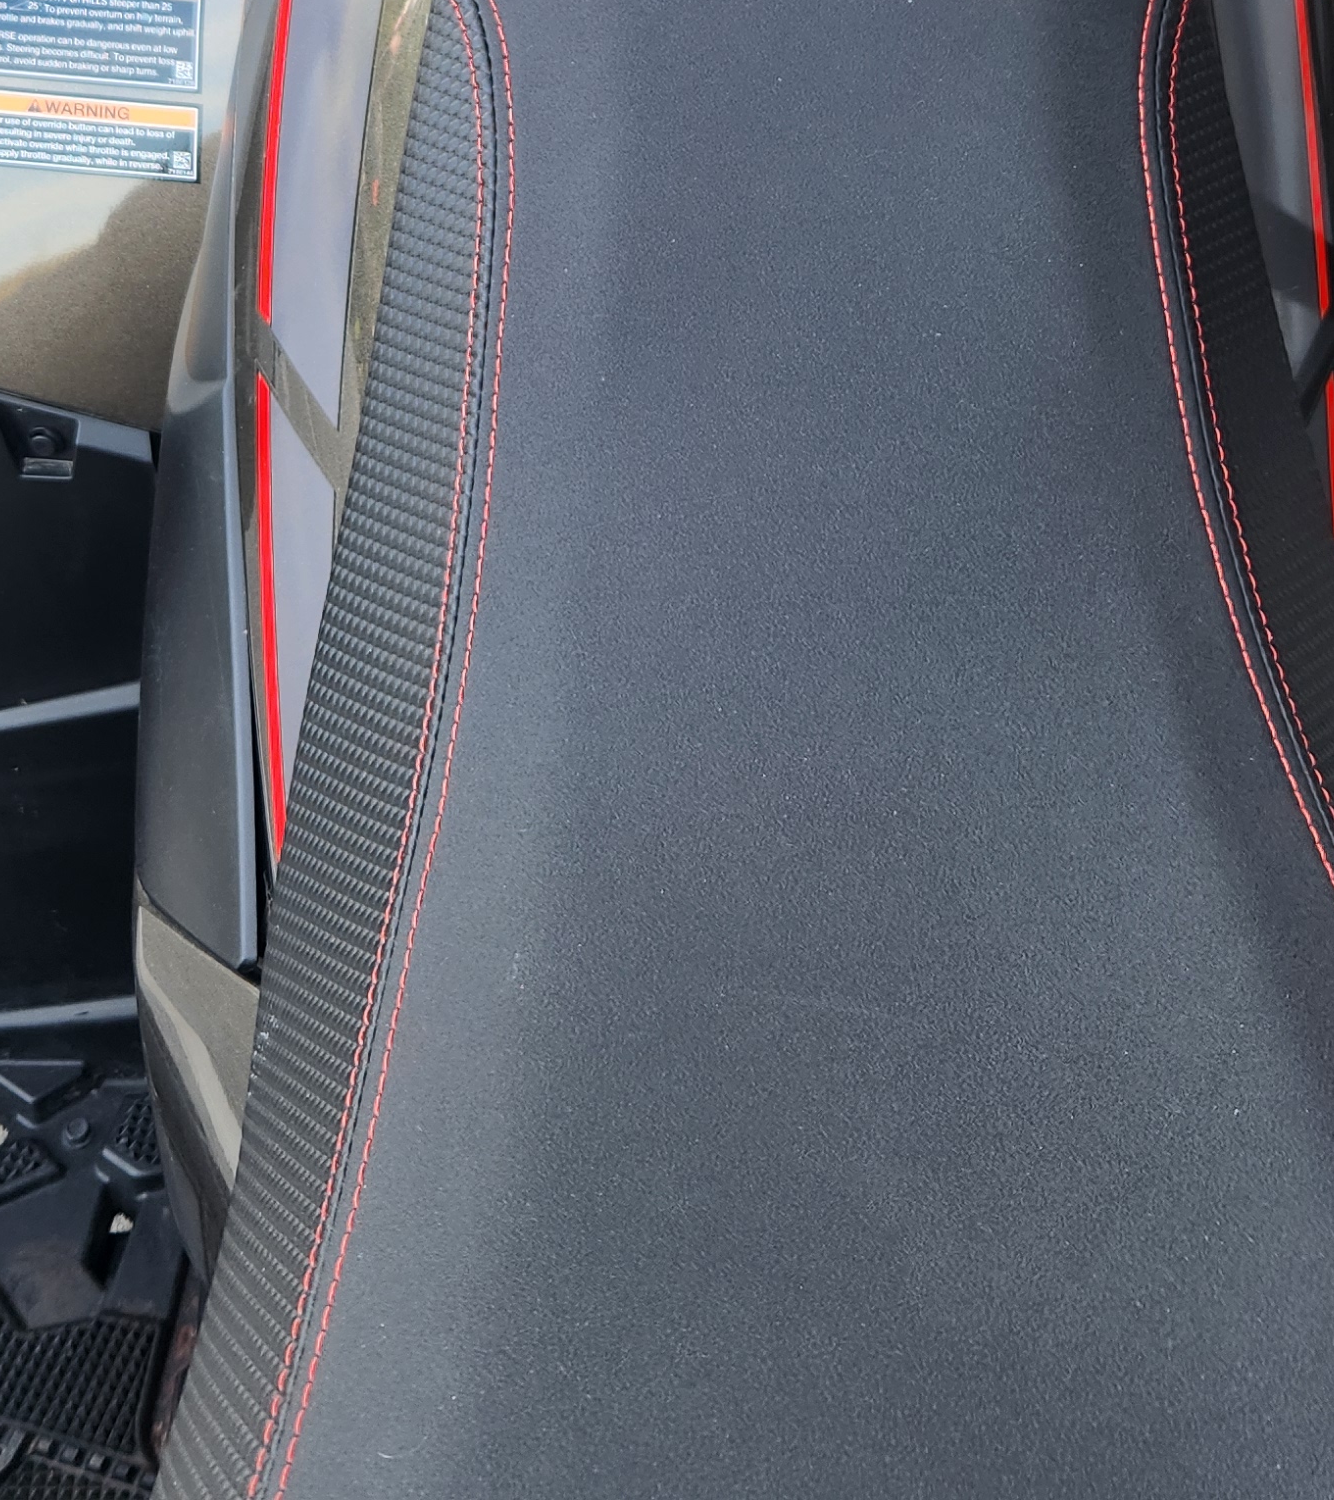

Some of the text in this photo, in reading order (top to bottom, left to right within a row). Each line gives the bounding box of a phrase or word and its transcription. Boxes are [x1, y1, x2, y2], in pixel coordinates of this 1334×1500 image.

[57, 6, 87, 17] prevent
[89, 10, 122, 19] overturn
[141, 1, 160, 10] than
[20, 14, 36, 23] and
[37, 16, 64, 26] brakes
[108, 22, 123, 31] and
[125, 23, 142, 32] shift
[144, 26, 171, 37] weight
[18, 33, 56, 44] operation
[57, 37, 72, 45] can
[86, 39, 129, 50] dangerous
[131, 43, 151, 51] even
[163, 45, 178, 54] low
[6, 43, 40, 56] Steering
[41, 46, 79, 58] becomes
[126, 55, 156, 65] prevent
[158, 56, 175, 66] loss
[14, 57, 134, 76] avoid sudden braking sharp
[45, 100, 130, 120] WARNING
[5, 117, 20, 125] use
[32, 119, 67, 129] override
[68, 121, 97, 132] button
[98, 125, 113, 133] can
[116, 126, 134, 135] lead
[147, 129, 164, 137] loss
[43, 132, 71, 140] severe
[73, 133, 95, 144] injury
[109, 136, 136, 146] death.
[20, 150, 51, 160] throttle
[95, 157, 117, 166] while
[29, 141, 64, 150] override
[65, 143, 87, 153] while
[89, 145, 119, 155] throttle
[130, 150, 170, 161] engaged.
